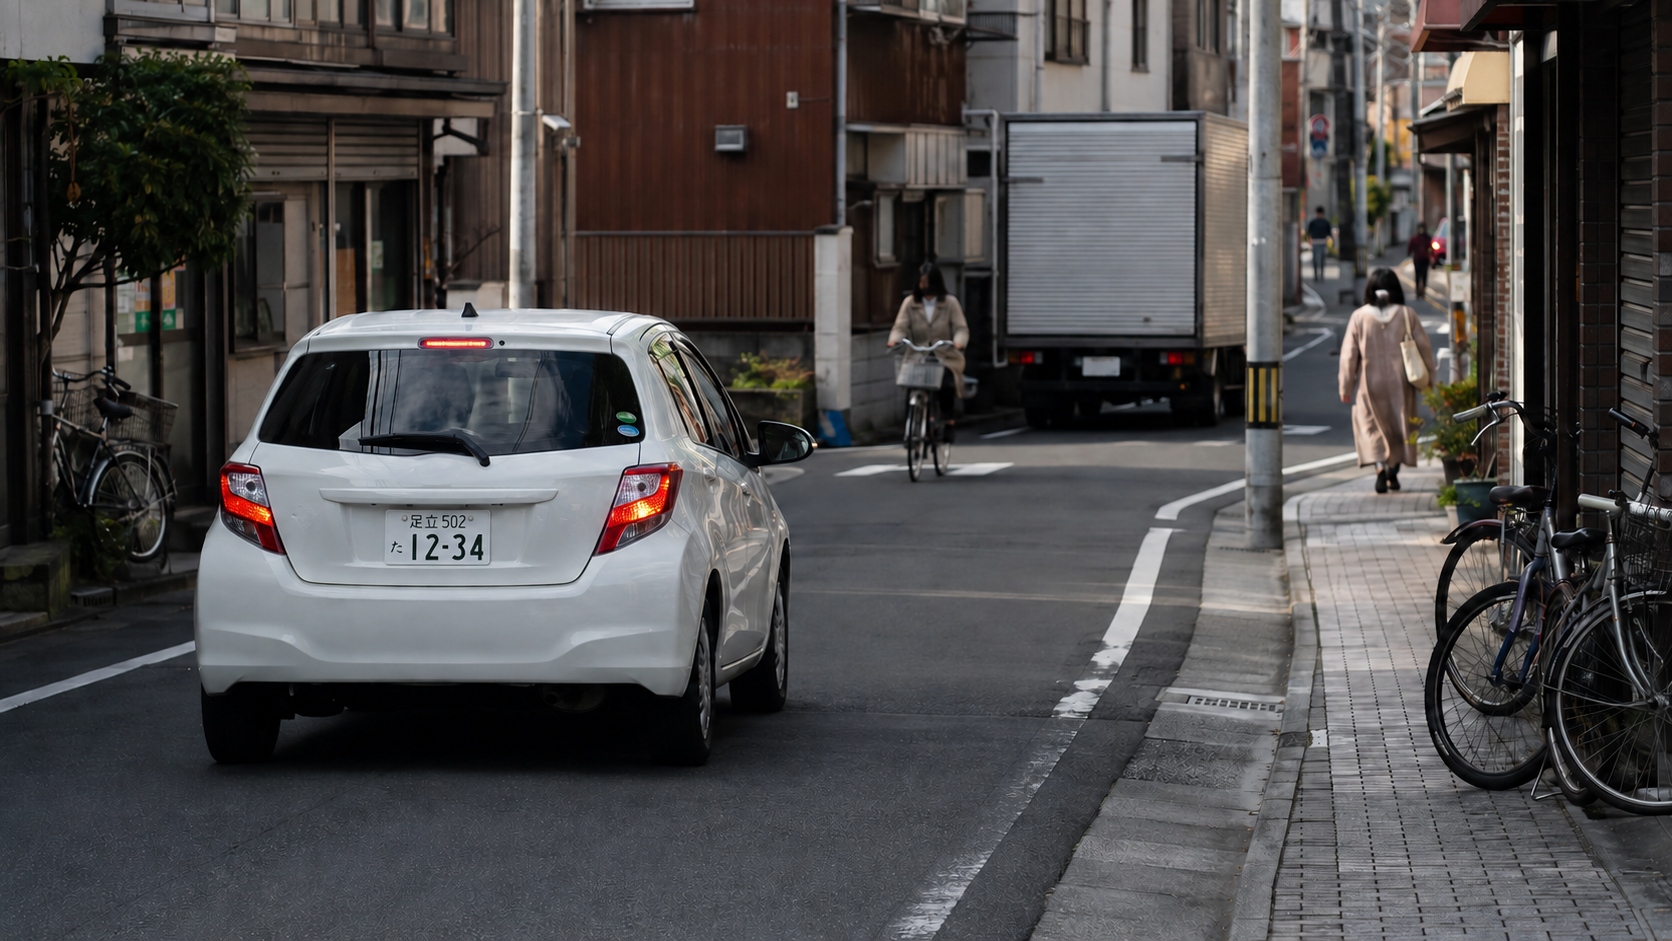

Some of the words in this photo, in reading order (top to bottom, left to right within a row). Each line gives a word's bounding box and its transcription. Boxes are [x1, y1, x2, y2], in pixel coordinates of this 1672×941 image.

[410, 514, 438, 529] 足立
[442, 514, 466, 529] 502
[390, 541, 403, 554] た
[411, 533, 484, 561] 12-34
